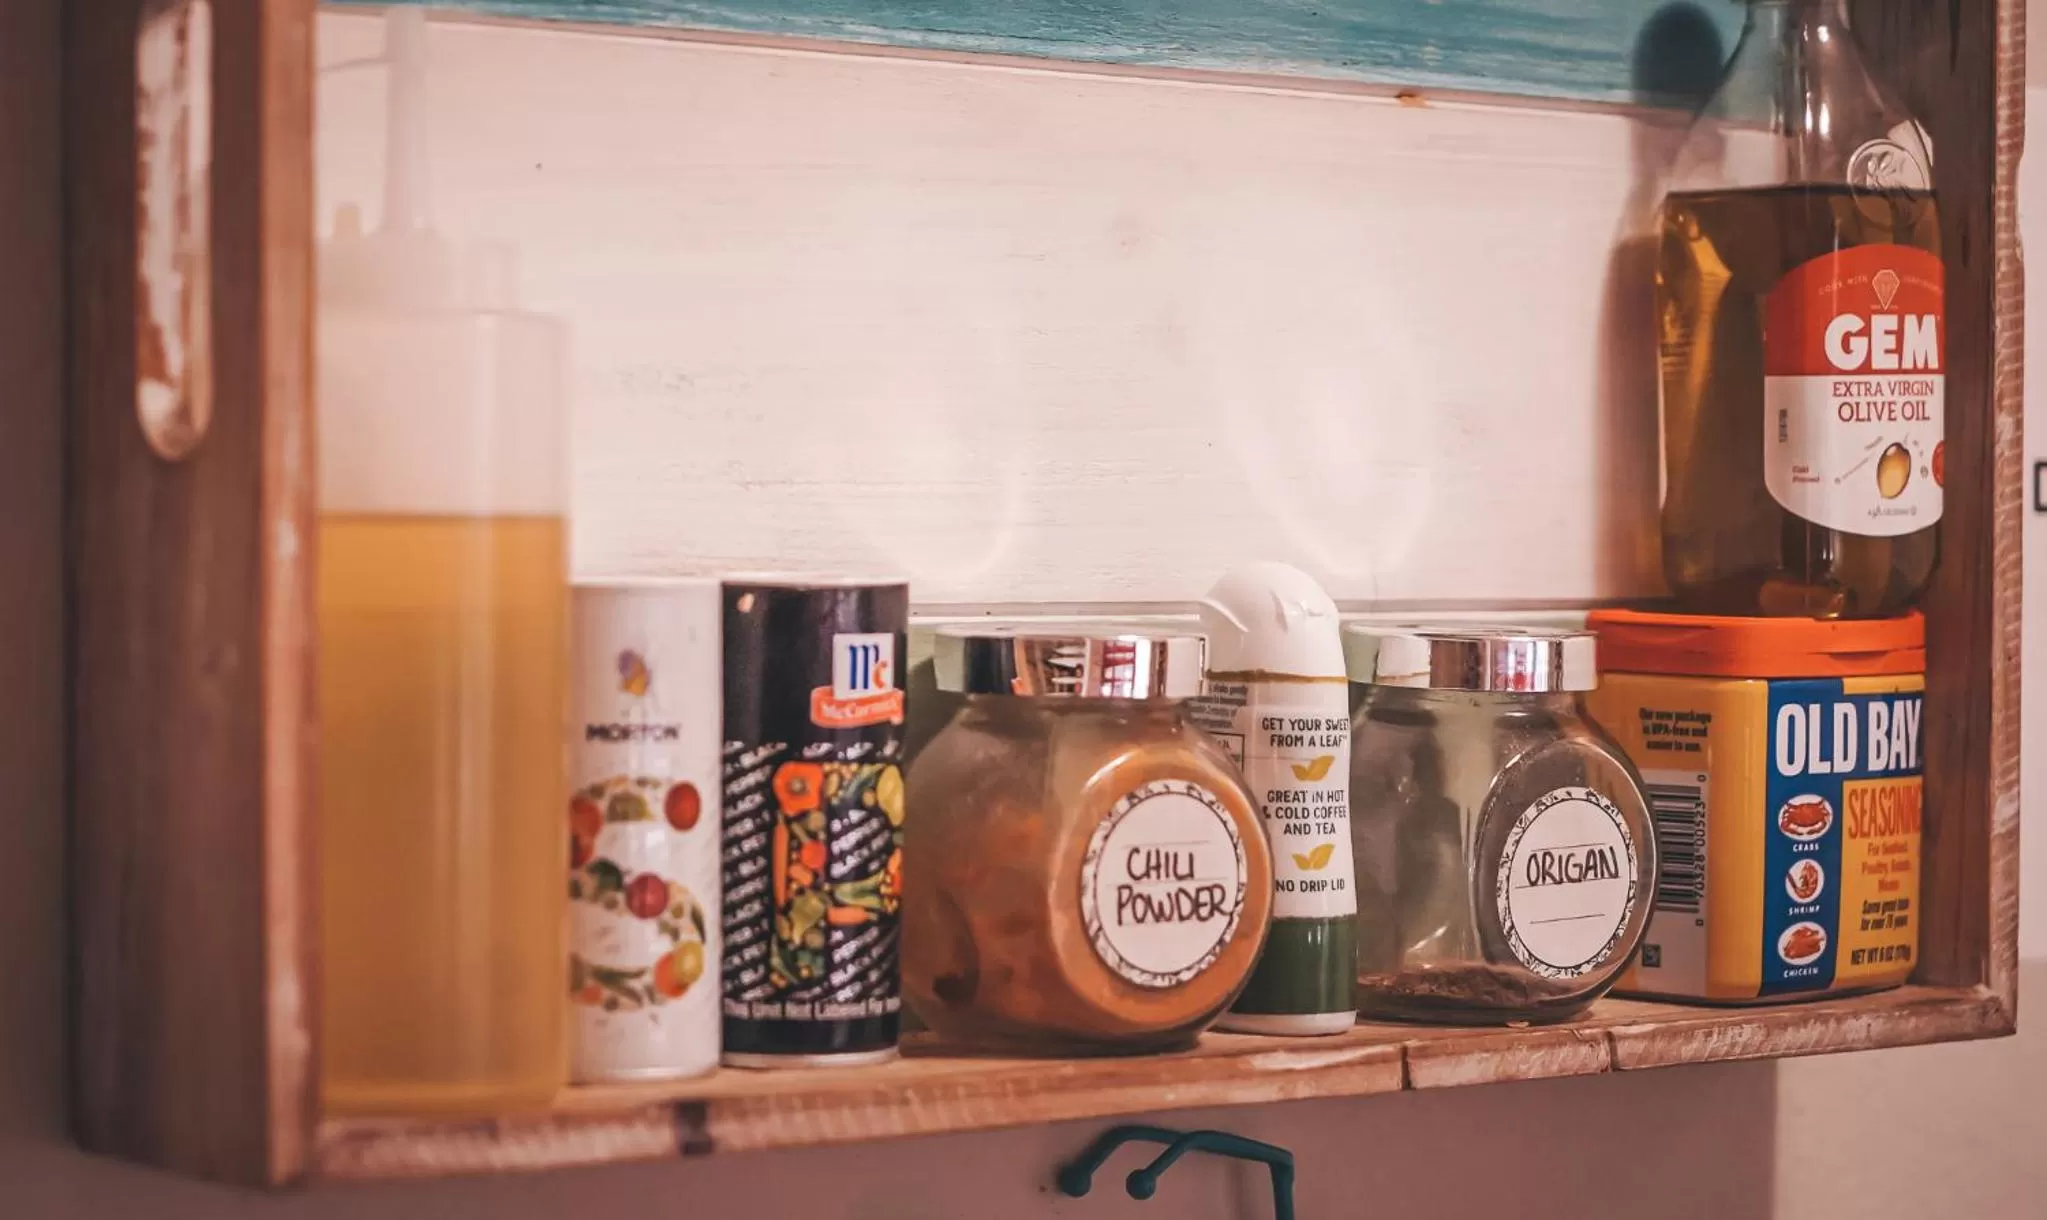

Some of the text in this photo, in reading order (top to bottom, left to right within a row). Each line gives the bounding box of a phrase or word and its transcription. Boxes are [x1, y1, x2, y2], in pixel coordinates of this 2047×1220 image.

[1824, 313, 1939, 370] GEM
[1832, 380, 1934, 397] EXTRA VIRGIN
[1838, 400, 1930, 422] OLIVE OIL
[1262, 717, 1284, 731] GET
[1288, 718, 1321, 731] YOUR
[585, 722, 681, 743] MORTON
[1776, 699, 1921, 776] OLD BAY
[1270, 733, 1304, 747] FROM
[1308, 735, 1316, 747] A
[1267, 790, 1307, 803] GREAT
[1327, 790, 1344, 802] HOT
[1275, 806, 1310, 819] COLD
[1314, 806, 1347, 818] COFFEE
[1283, 822, 1336, 835] AND TEA
[1793, 842, 1819, 852] CRABS
[1526, 846, 1620, 886] ORIGAN
[1275, 879, 1345, 892] NO DRIP LID
[1116, 883, 1233, 927] POWDER
[1788, 904, 1820, 915] SHRIMP
[1851, 949, 1866, 965] NET
[1867, 947, 1879, 964] WT
[1783, 967, 1819, 978] CHICKEN
